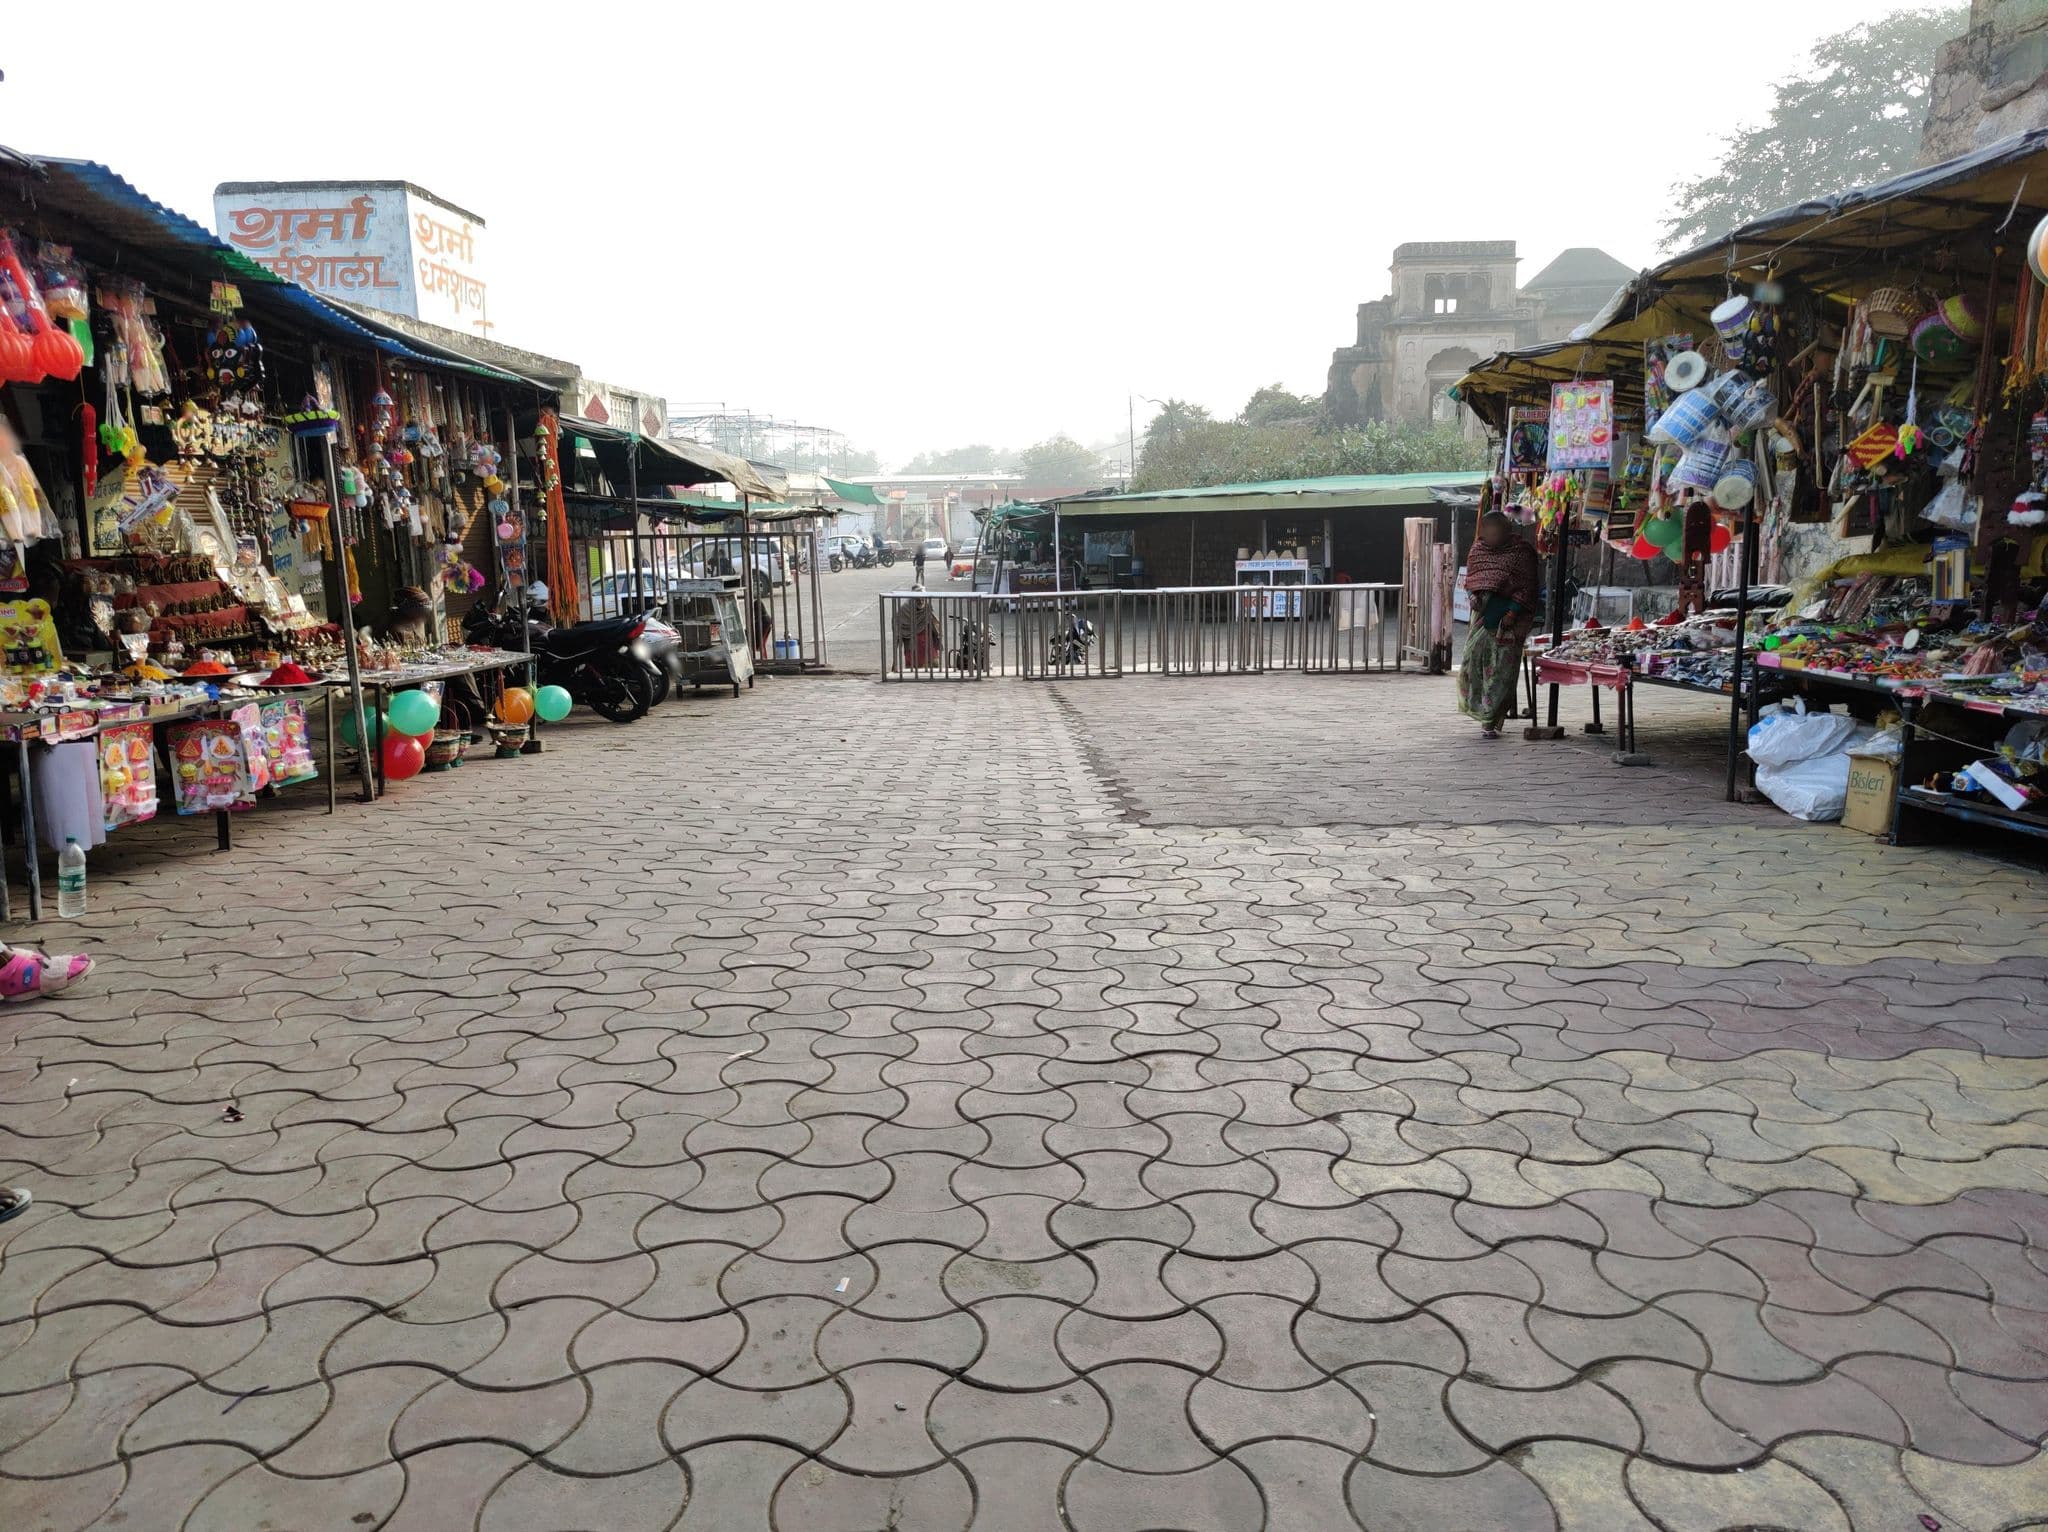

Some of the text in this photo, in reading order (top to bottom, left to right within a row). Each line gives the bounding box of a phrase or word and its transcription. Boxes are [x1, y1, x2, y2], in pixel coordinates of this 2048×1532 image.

[229, 195, 376, 248] शर्मा
[415, 211, 475, 264] शर्मा
[256, 247, 400, 292] र्मशाला
[1850, 770, 1885, 791] Bisleri
